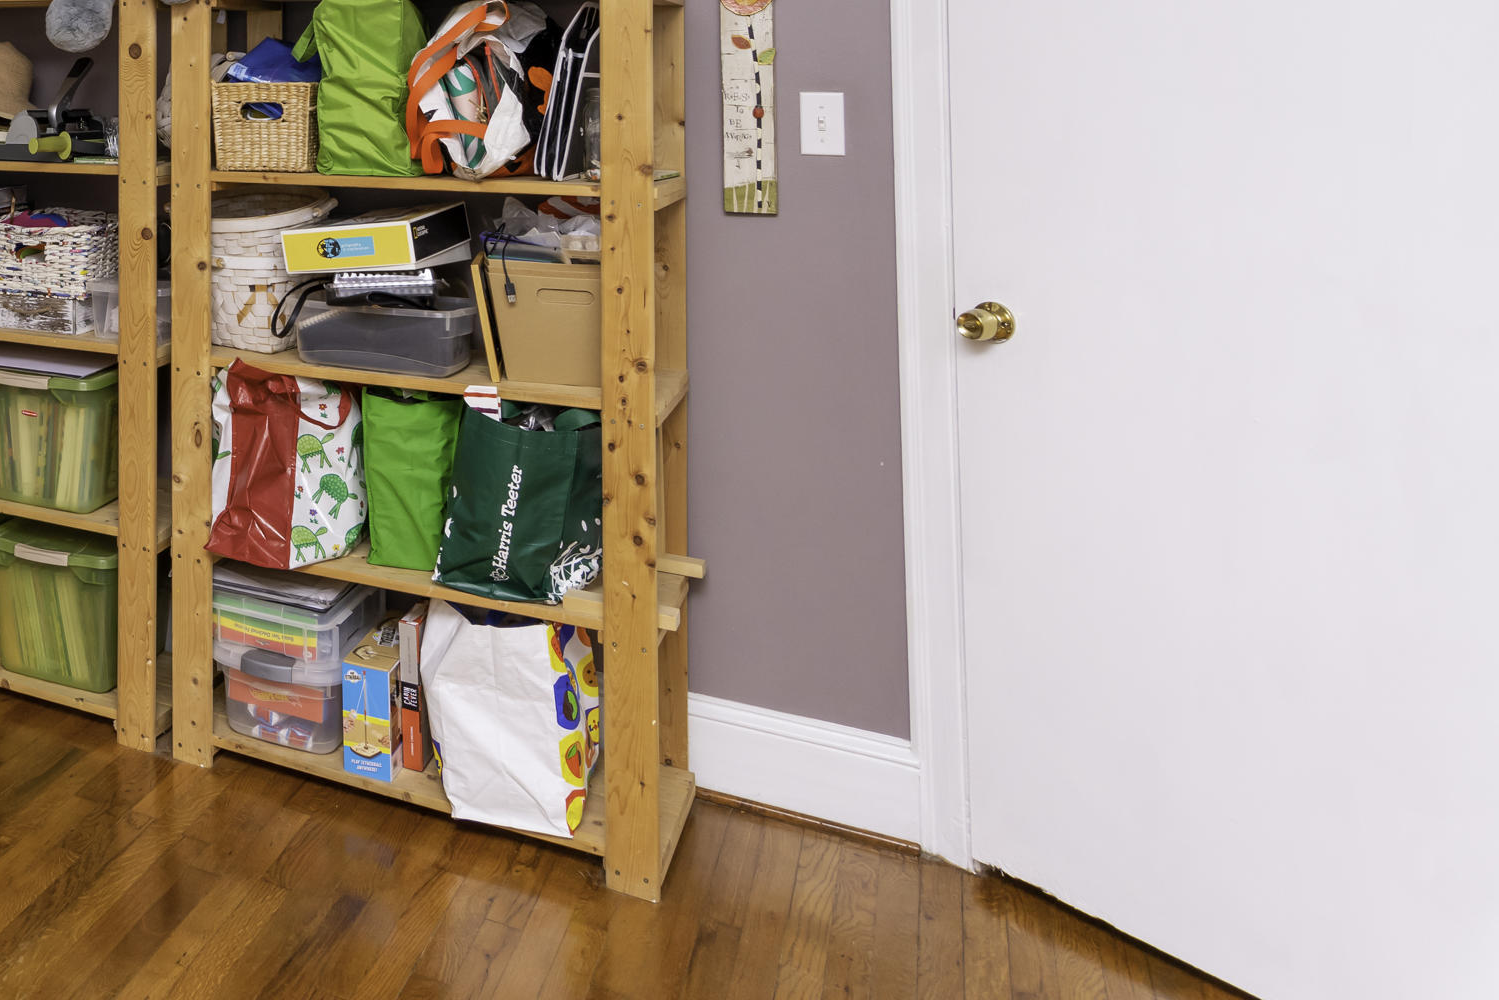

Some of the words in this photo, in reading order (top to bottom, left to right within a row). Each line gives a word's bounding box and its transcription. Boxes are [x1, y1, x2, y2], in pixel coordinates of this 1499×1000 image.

[501, 464, 522, 517] Teeter
[492, 521, 513, 570] Harris
[403, 686, 411, 706] CABIN
[410, 687, 418, 708] FEVER
